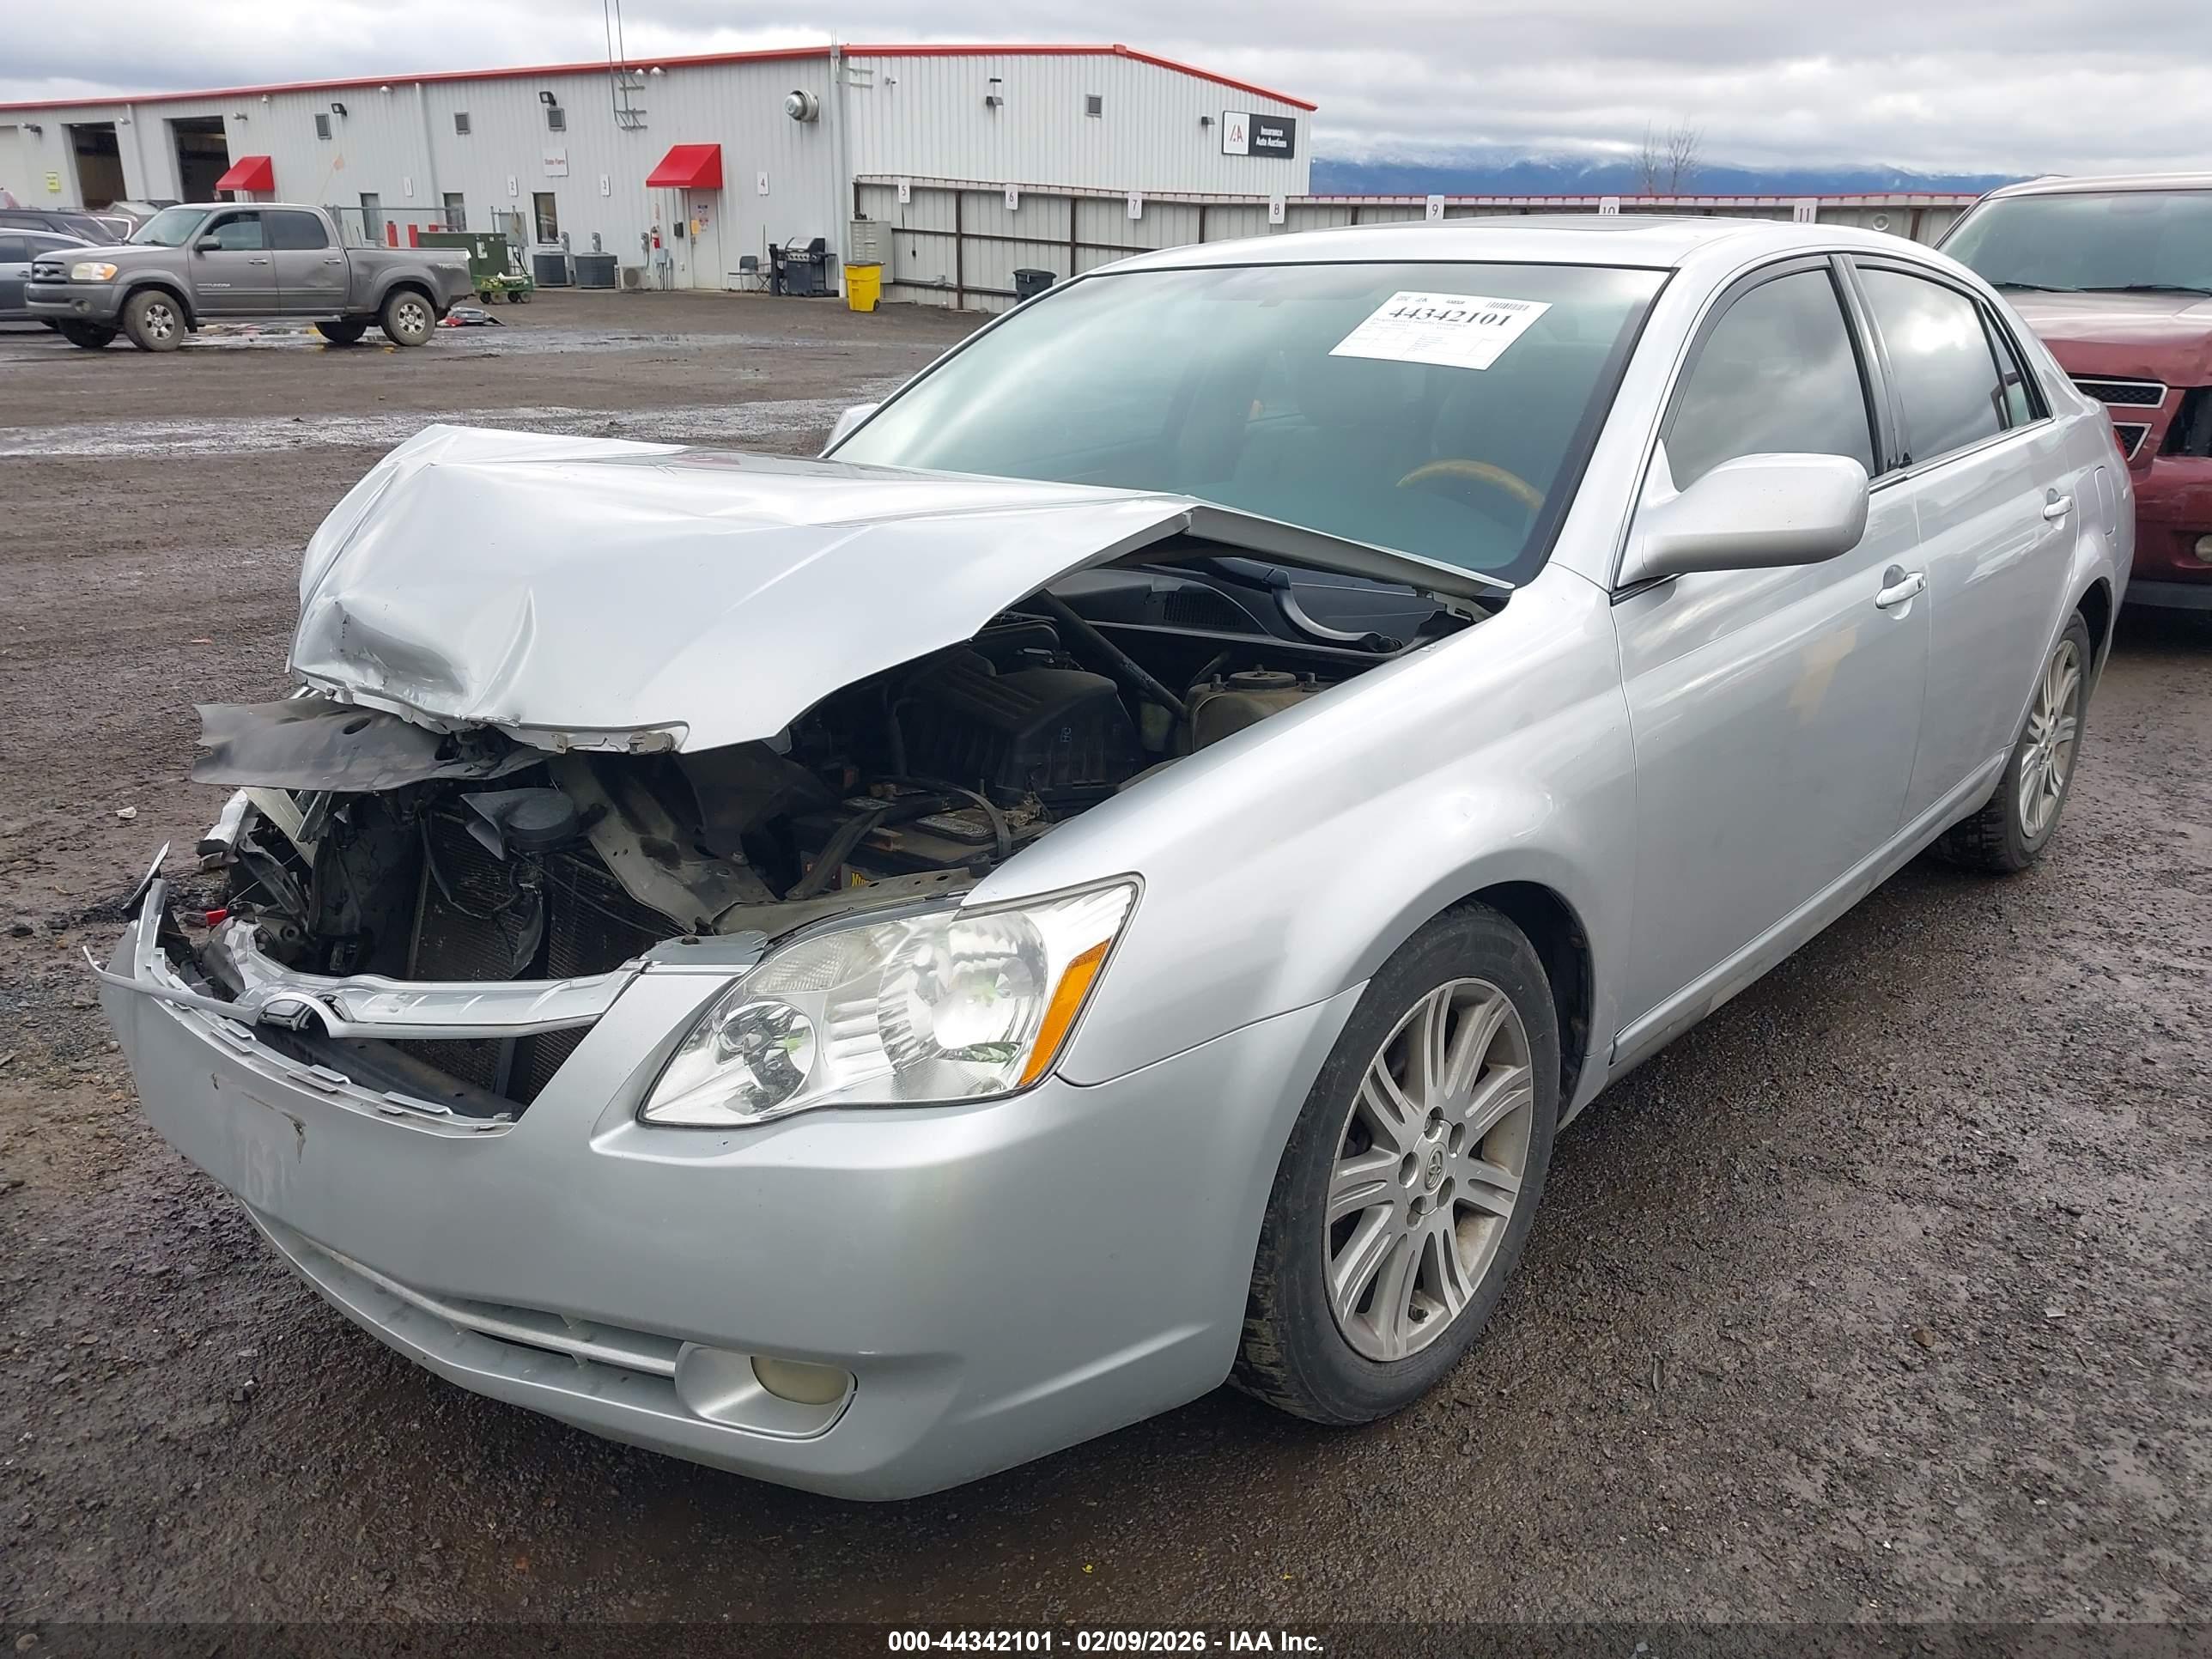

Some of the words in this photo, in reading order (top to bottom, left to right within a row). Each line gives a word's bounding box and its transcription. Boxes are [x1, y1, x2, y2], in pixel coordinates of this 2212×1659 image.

[760, 178, 766, 188] 4
[902, 185, 907, 197] 5
[1009, 191, 1014, 203] 6
[1133, 199, 1138, 211] 7
[1274, 203, 1279, 215] 8
[1432, 204, 1439, 216] 9
[1800, 208, 1810, 222] 11
[1389, 307, 1512, 326] 44342101
